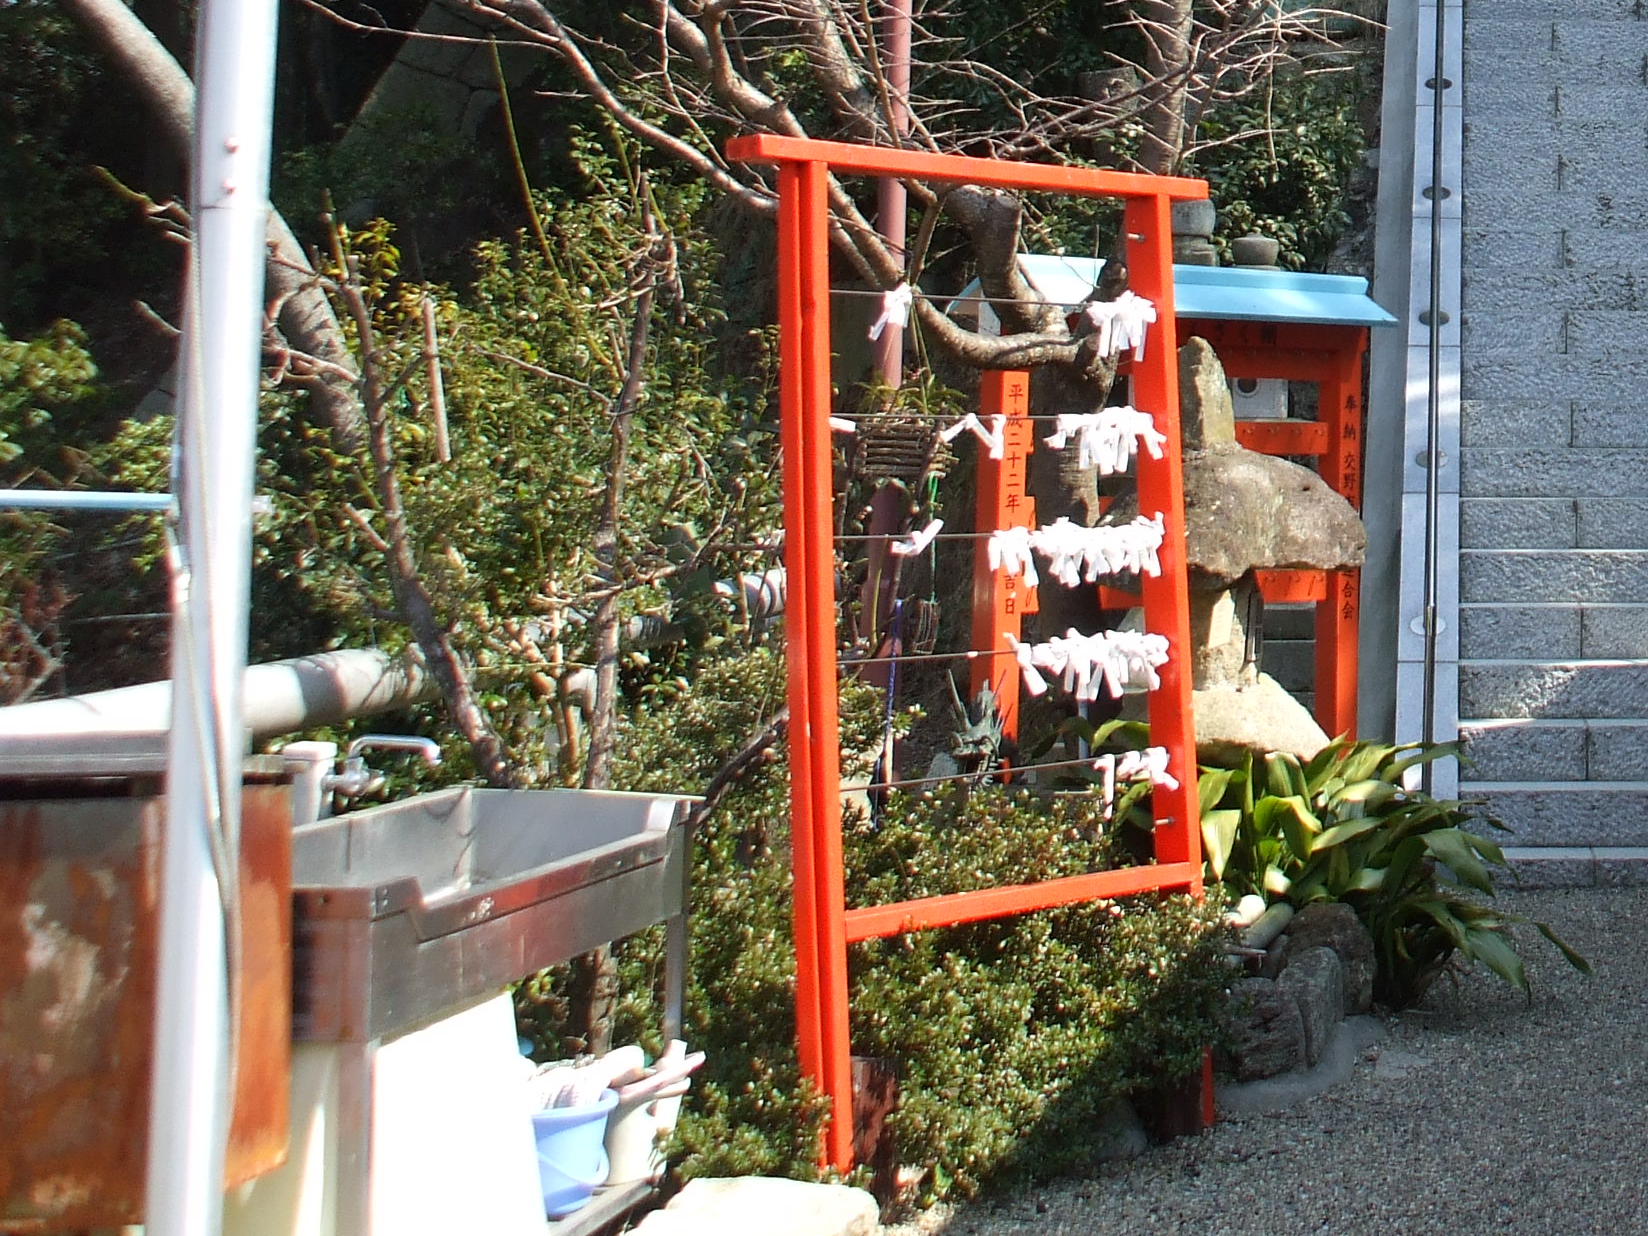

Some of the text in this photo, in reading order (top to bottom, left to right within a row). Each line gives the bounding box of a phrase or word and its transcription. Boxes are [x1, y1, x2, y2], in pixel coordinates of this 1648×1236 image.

[1004, 384, 1025, 615] 平成二十二年吉日
